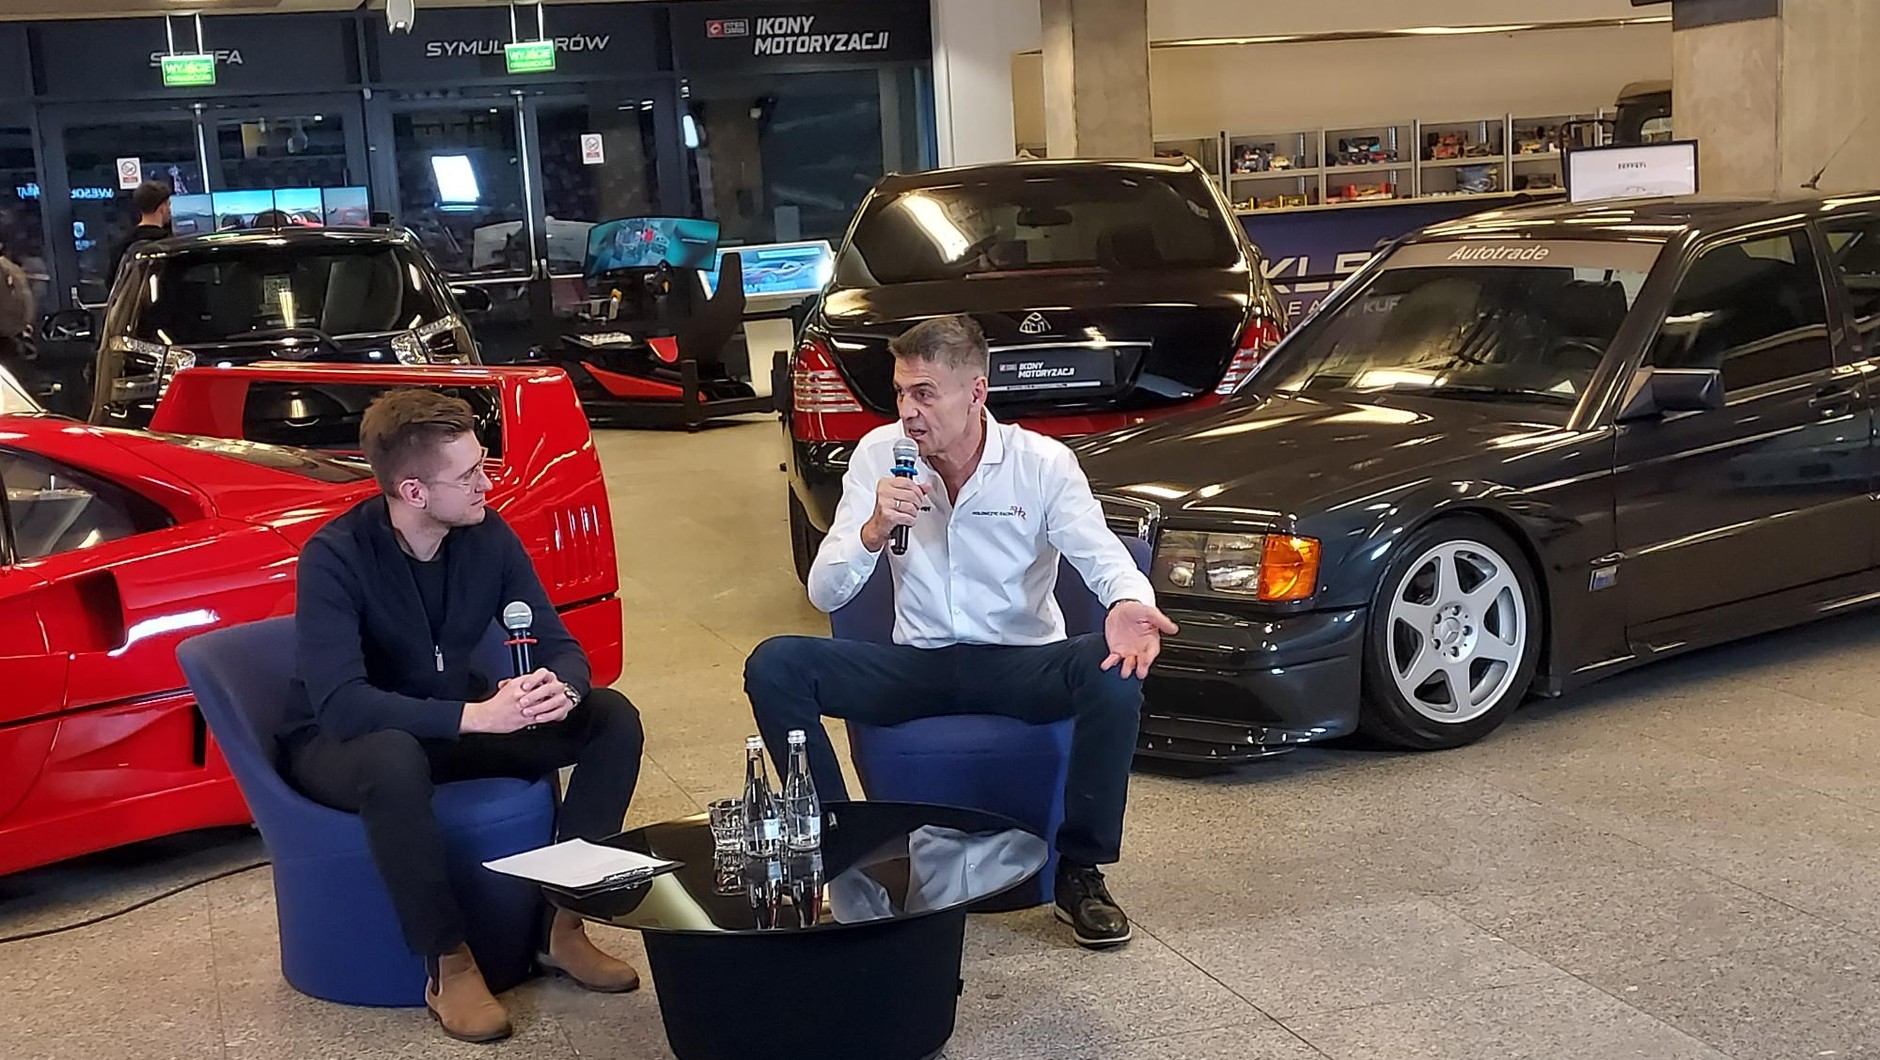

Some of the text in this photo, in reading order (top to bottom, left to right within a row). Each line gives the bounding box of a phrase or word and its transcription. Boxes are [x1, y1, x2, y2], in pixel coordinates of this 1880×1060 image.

[756, 16, 815, 35] IKONY
[426, 34, 610, 57] SYMULRÓW
[754, 32, 889, 55] MOTORYZACJI
[1447, 245, 1549, 260] Autotrade
[1018, 368, 1075, 378] MOTORYZACJI
[1019, 362, 1044, 371] IKONY
